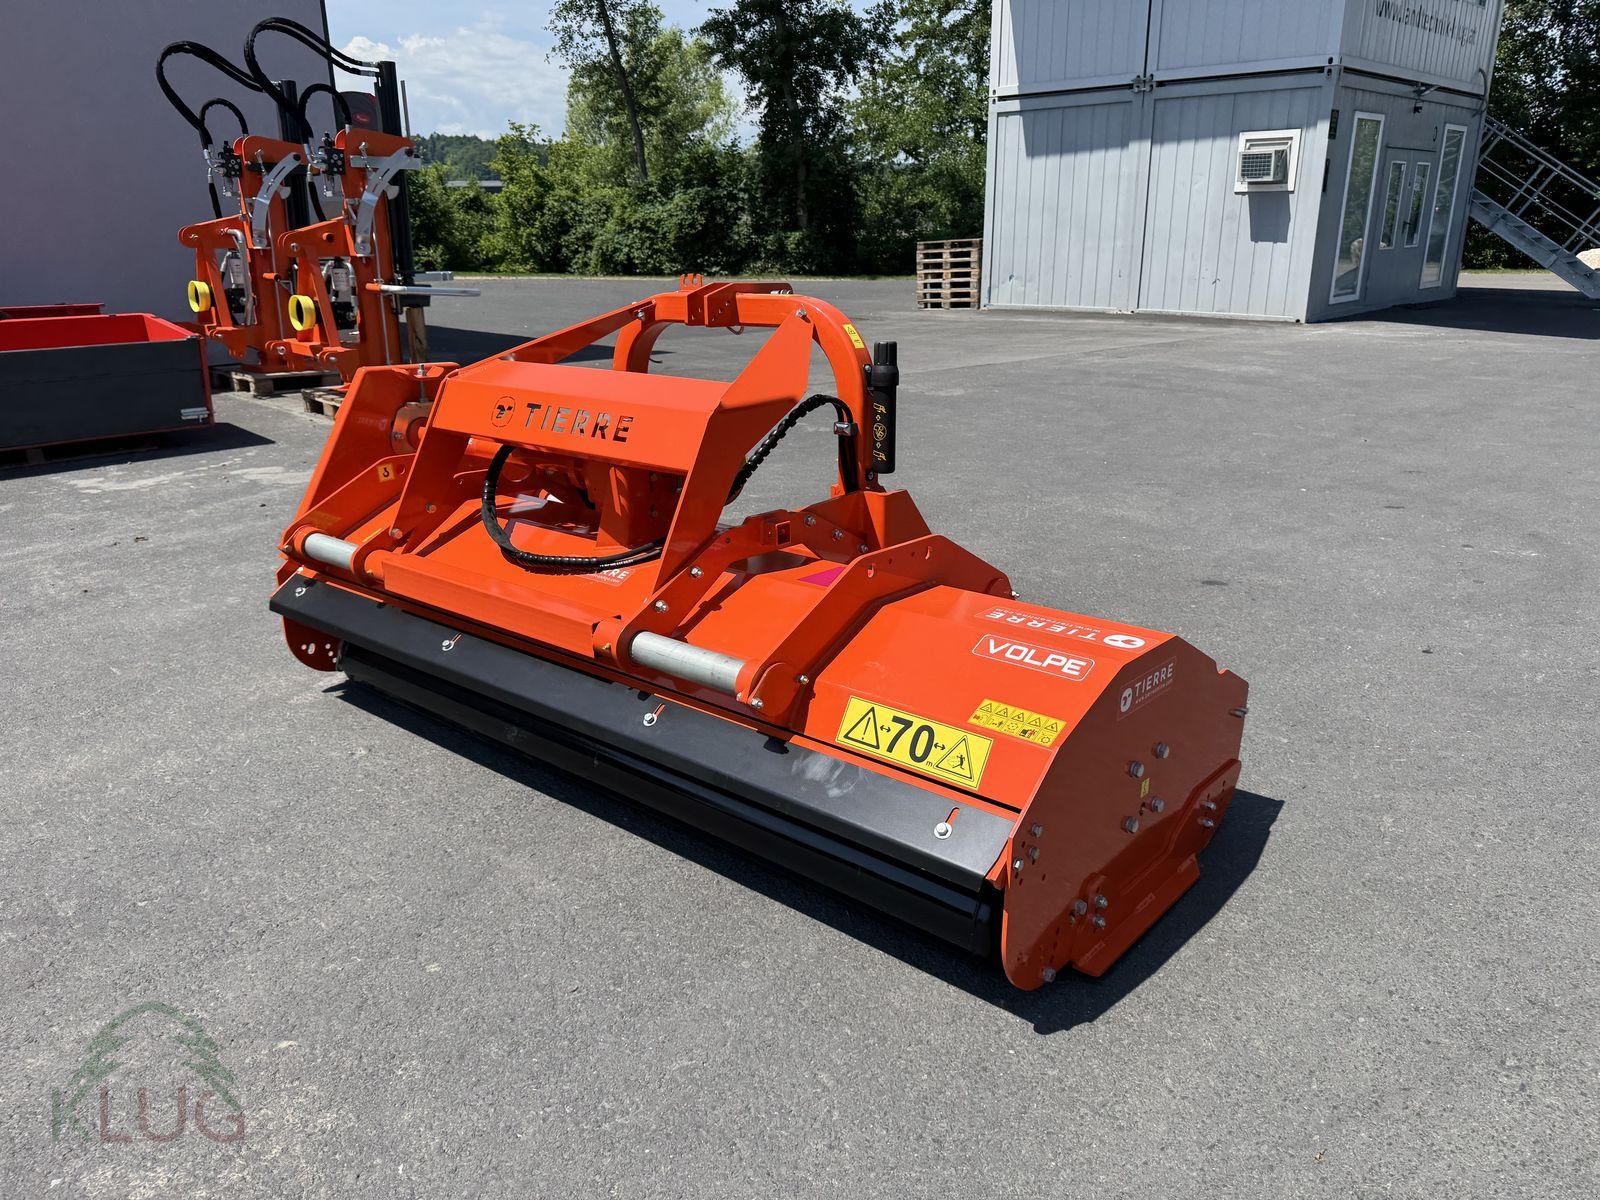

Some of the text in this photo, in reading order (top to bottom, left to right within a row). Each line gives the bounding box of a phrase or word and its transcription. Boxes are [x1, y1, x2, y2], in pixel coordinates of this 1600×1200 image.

[525, 402, 634, 443] TIERRE
[985, 610, 1097, 641] TIERRE
[989, 638, 1087, 676] VOLPE
[1134, 662, 1174, 698] TIERRE
[886, 715, 936, 764] 70
